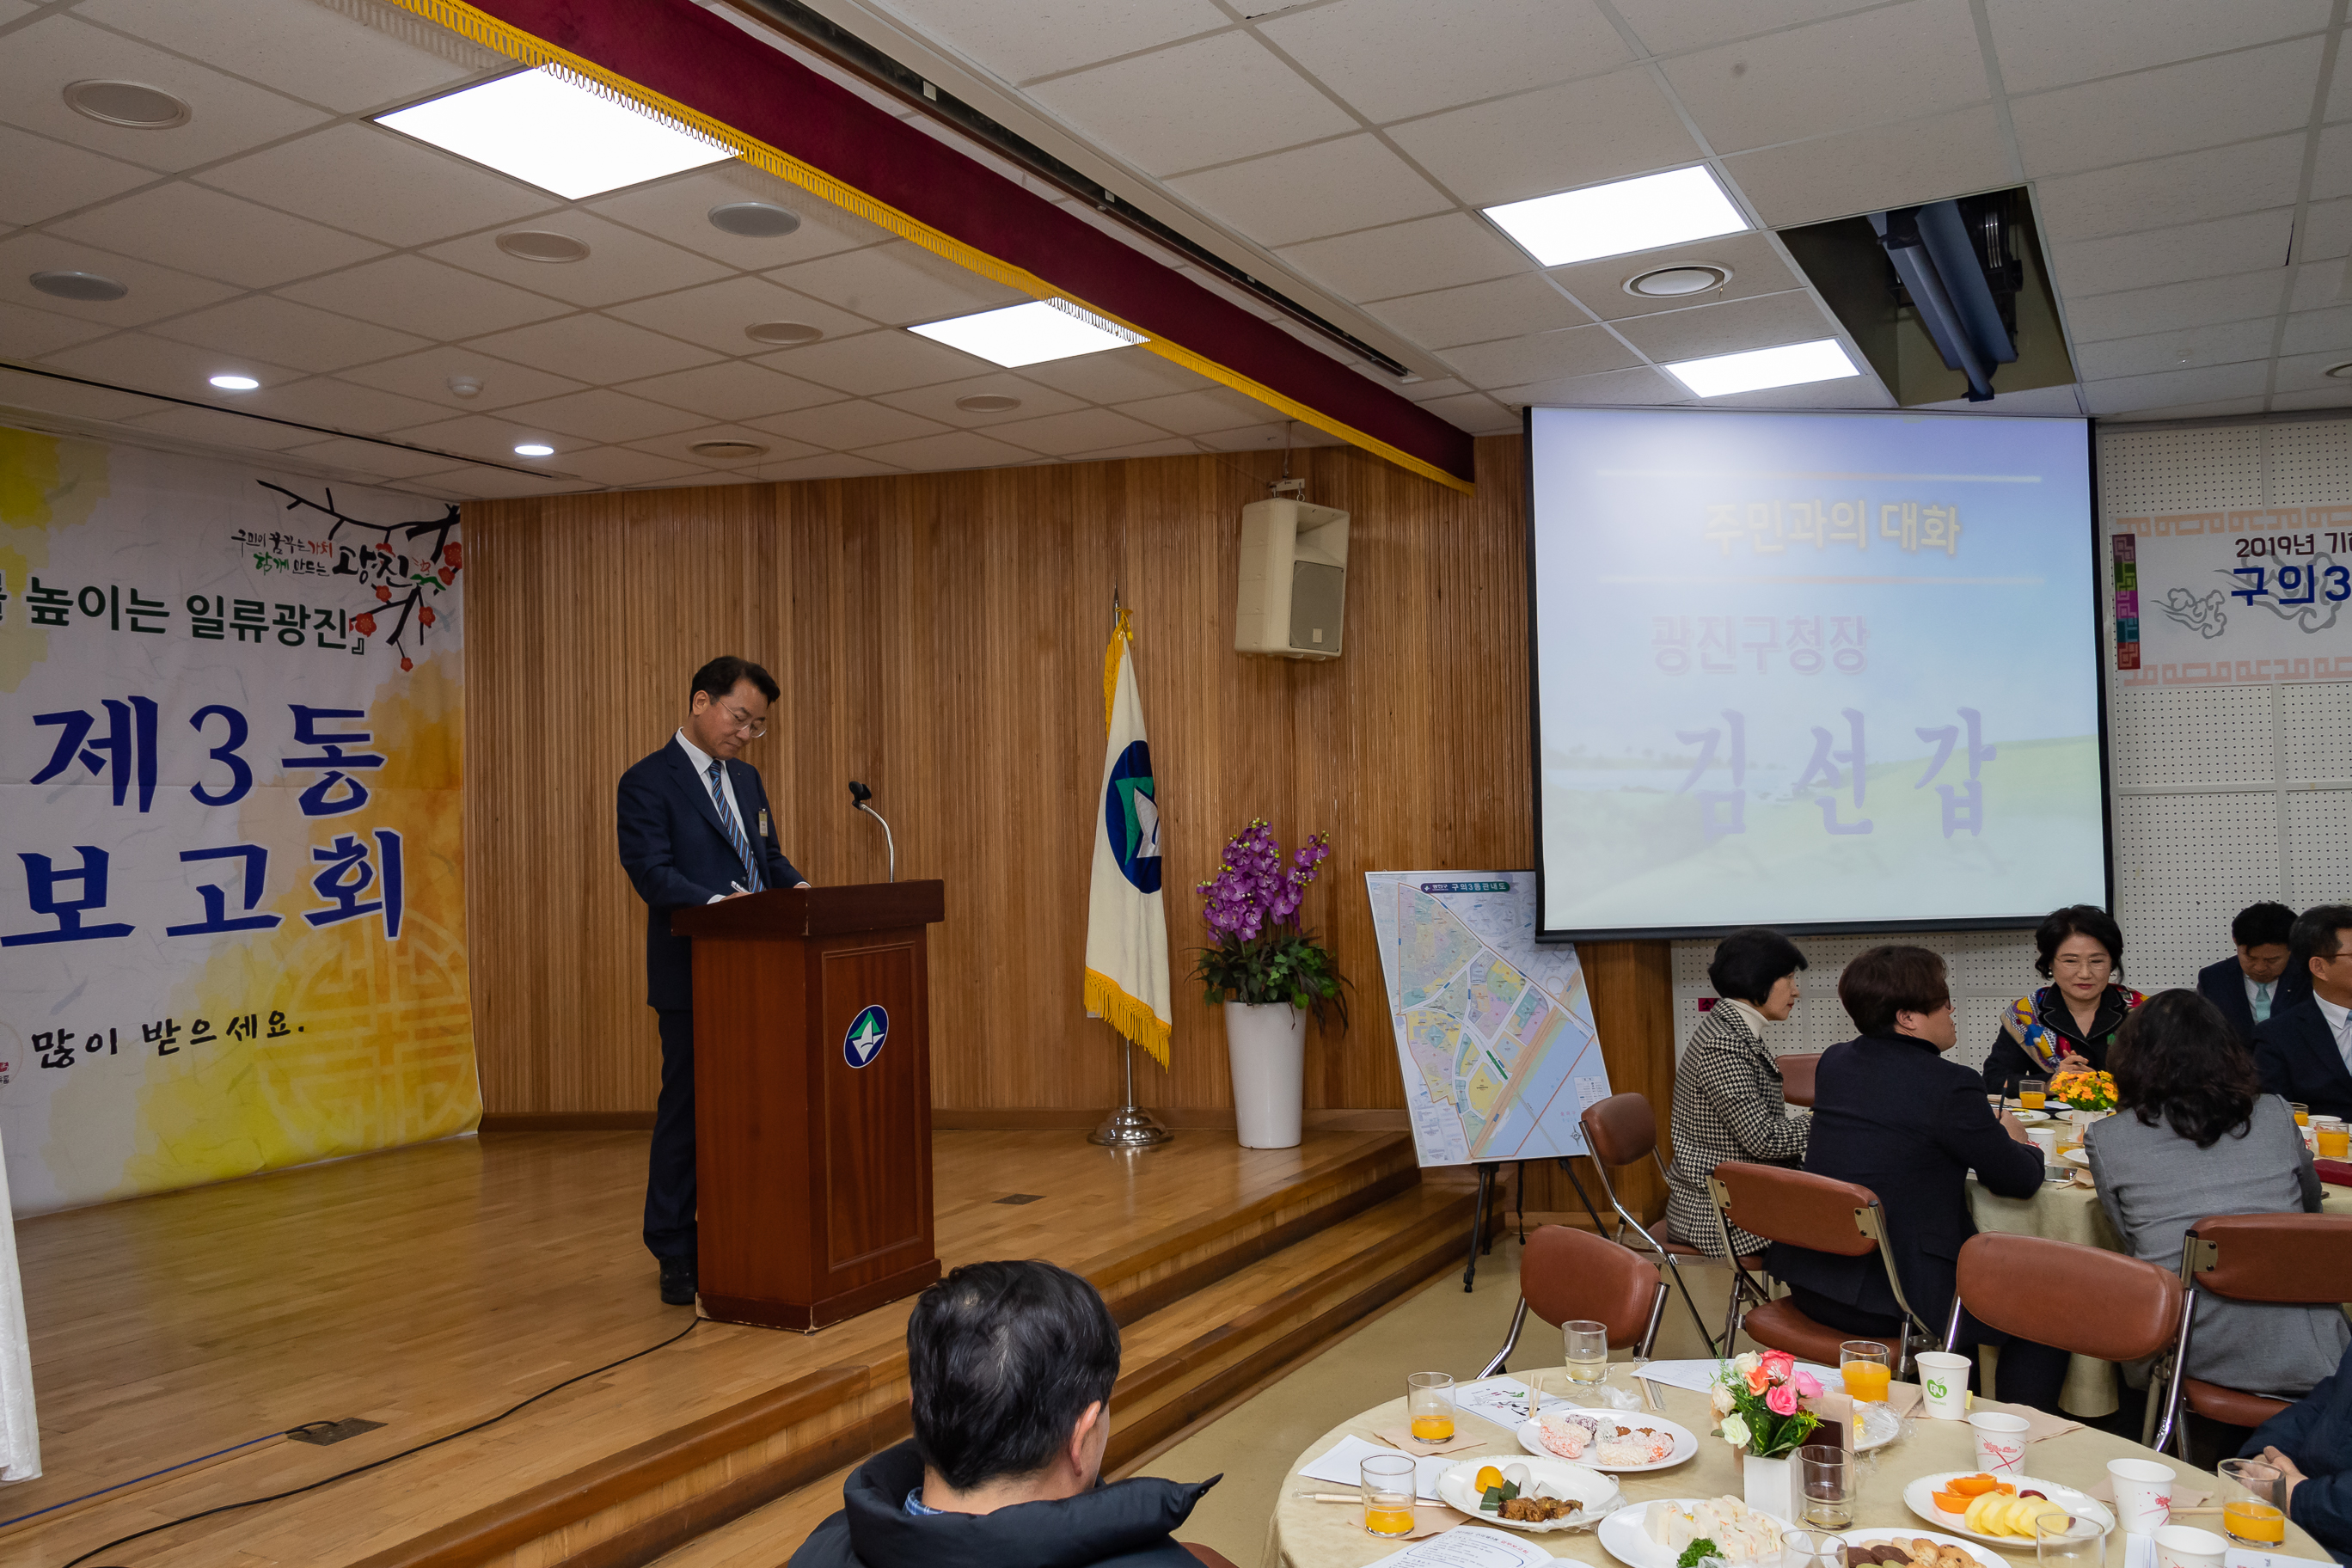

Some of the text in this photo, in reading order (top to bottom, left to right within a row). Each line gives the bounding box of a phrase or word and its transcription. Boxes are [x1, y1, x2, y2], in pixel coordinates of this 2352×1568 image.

[1703, 499, 1961, 555] 주민과의 대화
[2235, 531, 2352, 558] 2019년 기
[332, 544, 413, 588] 광진
[26, 576, 170, 634] 높이는
[1651, 616, 1869, 676] 광진구청장
[31, 1010, 305, 1069] 많이 받으세요.
